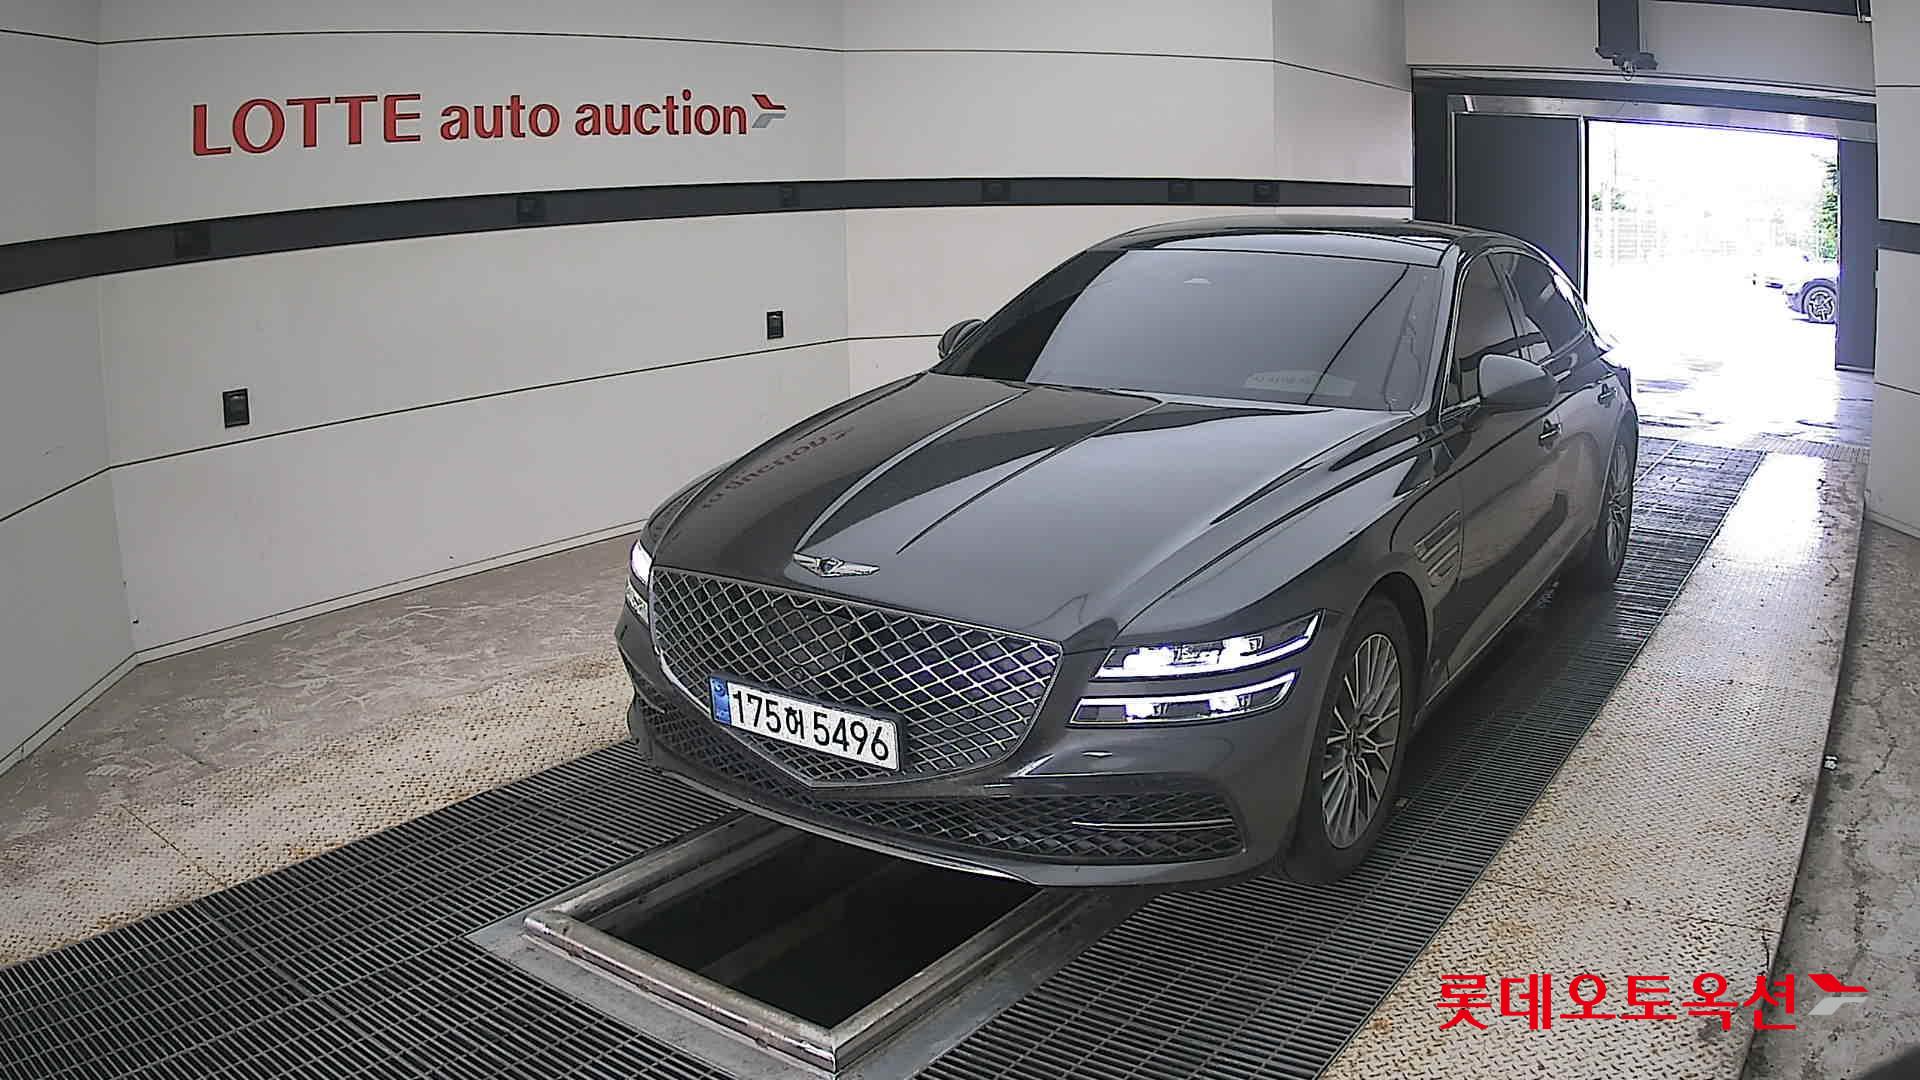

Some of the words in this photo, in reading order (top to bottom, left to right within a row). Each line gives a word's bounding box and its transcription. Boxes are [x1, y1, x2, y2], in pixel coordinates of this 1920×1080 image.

[192, 94, 422, 156] LOTTE
[439, 95, 560, 141] auto
[574, 89, 748, 136] auction
[732, 690, 805, 739] 175허
[813, 711, 889, 761] 5496
